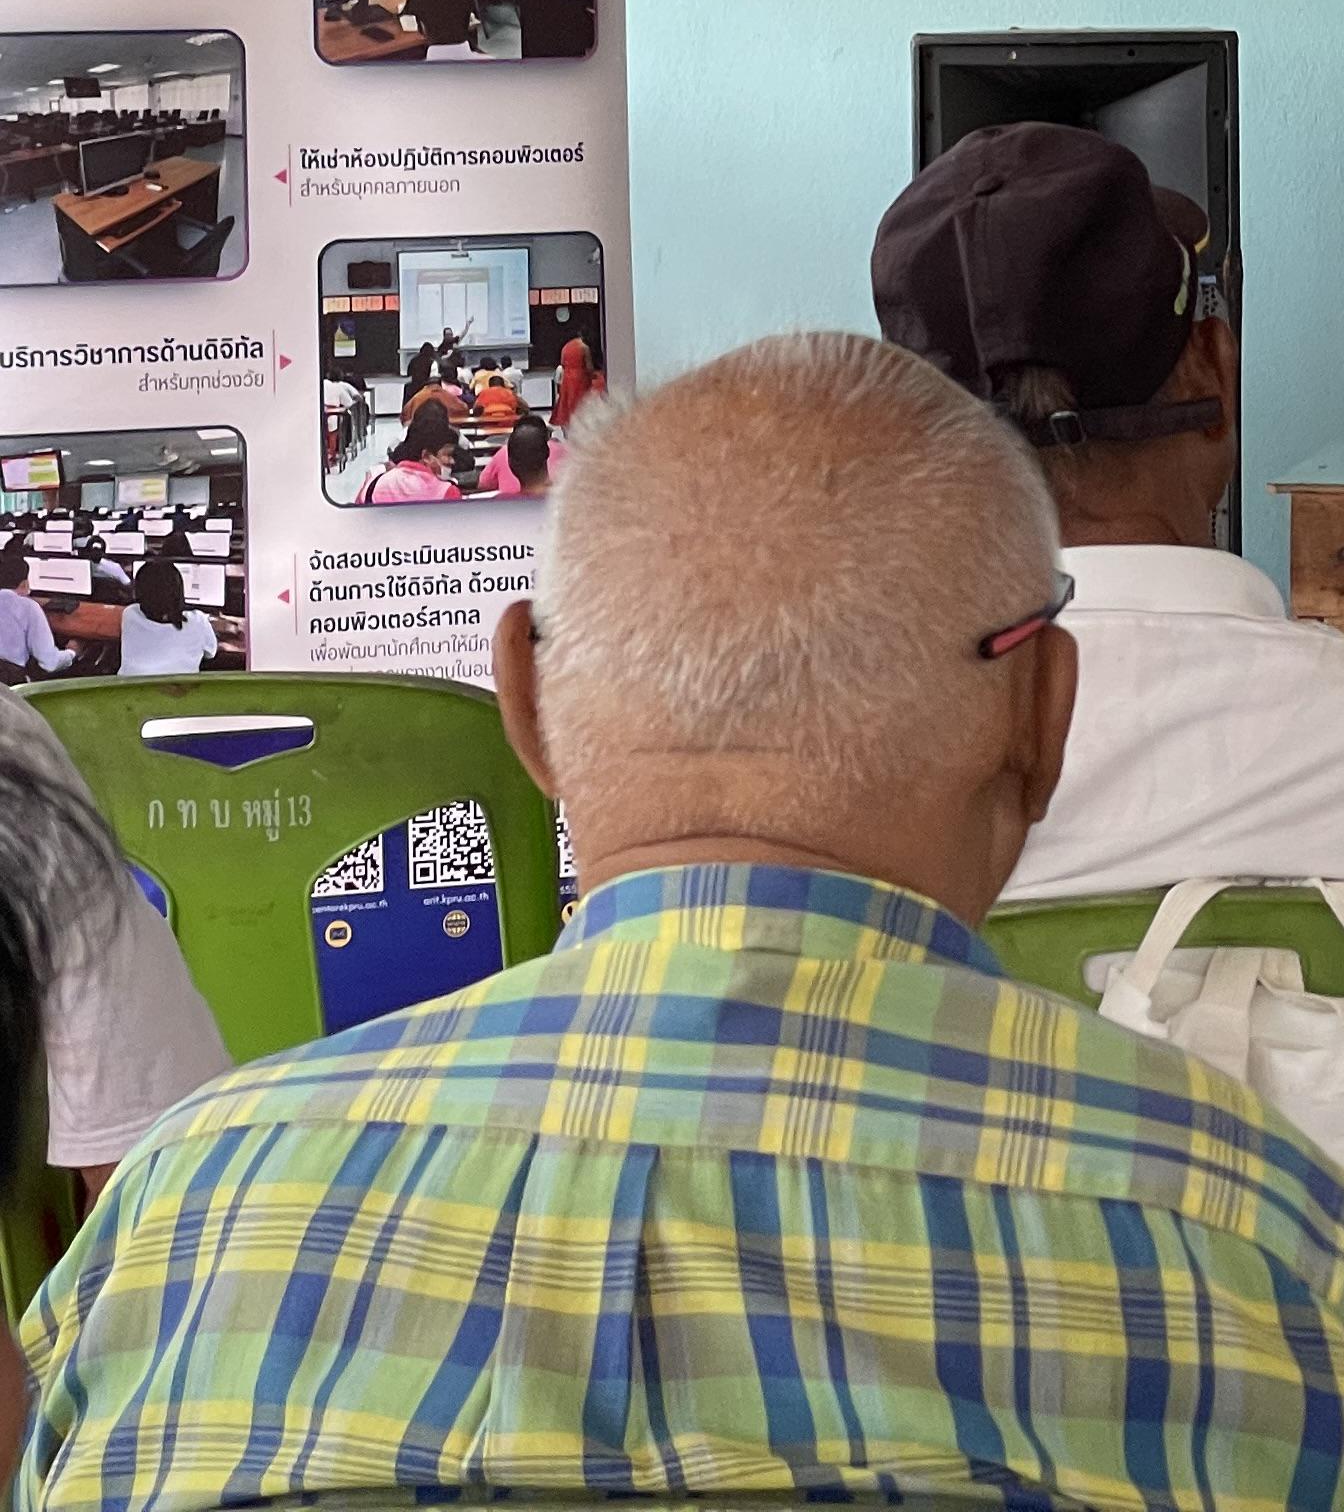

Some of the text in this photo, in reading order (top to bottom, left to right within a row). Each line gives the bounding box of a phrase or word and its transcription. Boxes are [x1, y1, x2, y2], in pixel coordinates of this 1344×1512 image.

[300, 142, 585, 170] ให้เช่าห้องปฏิบัติการคอมพิวเตอร์
[300, 177, 461, 199] สำหรับบุคคลภายนอก
[139, 370, 265, 394] สำหรับทุกช่วงวัย
[309, 544, 535, 571] จัดสอบประเมินสมรรถนะ
[309, 575, 462, 603] ด้านการใช้ดิจิทัล
[309, 606, 481, 634] คอมพิวเตอร์สากล
